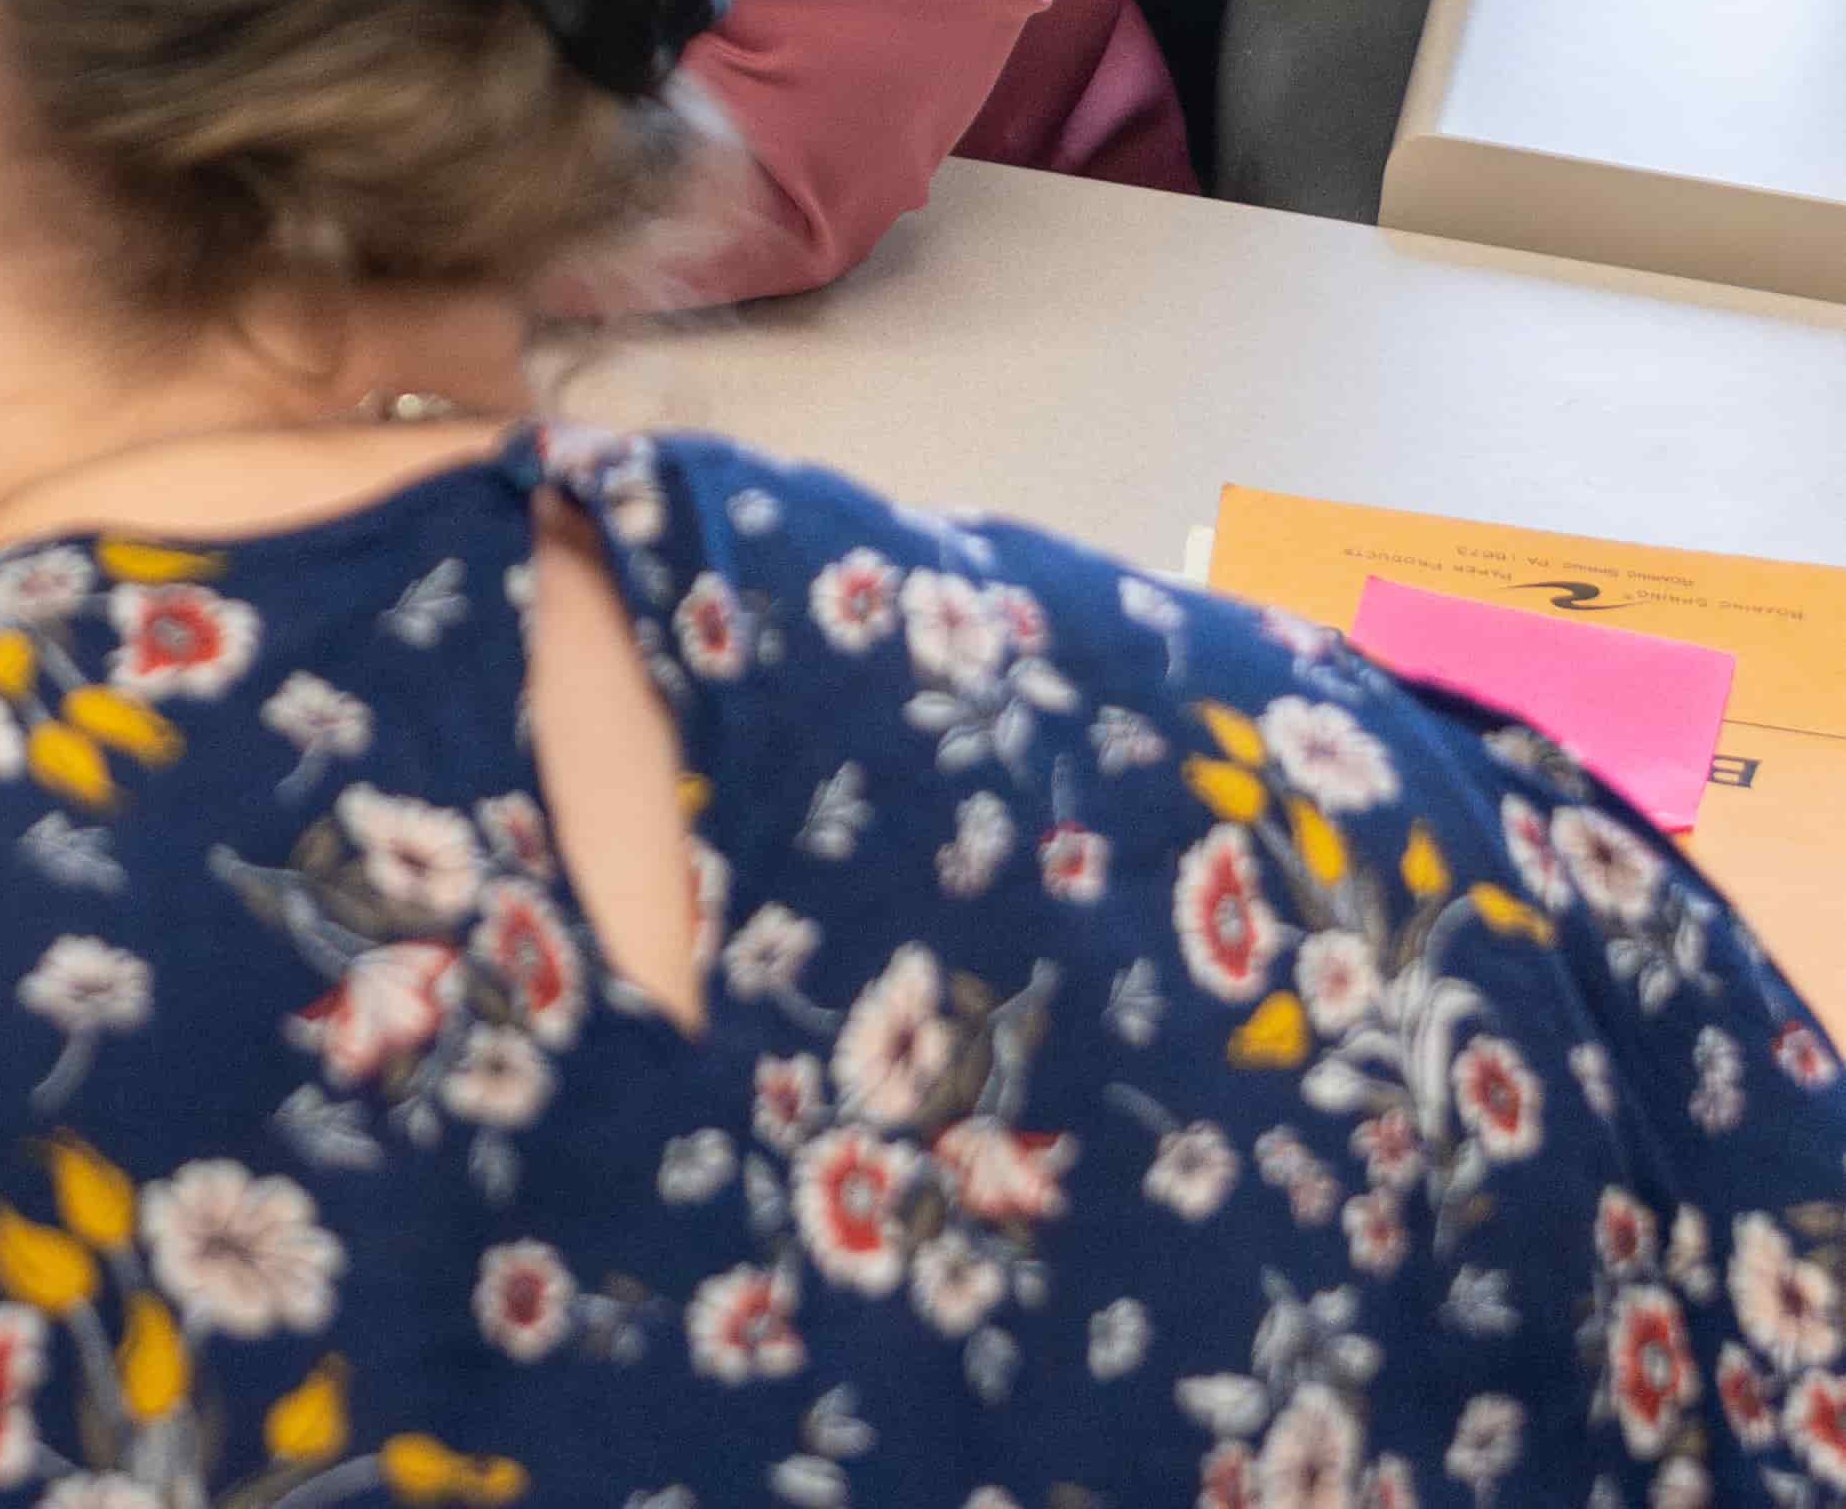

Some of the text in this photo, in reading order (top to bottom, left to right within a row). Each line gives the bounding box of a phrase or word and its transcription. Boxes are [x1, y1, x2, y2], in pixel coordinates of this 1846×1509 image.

[1343, 546, 1444, 573] PRODUCTS
[1528, 556, 1550, 572] PA
[1453, 563, 1513, 582] PAPER
